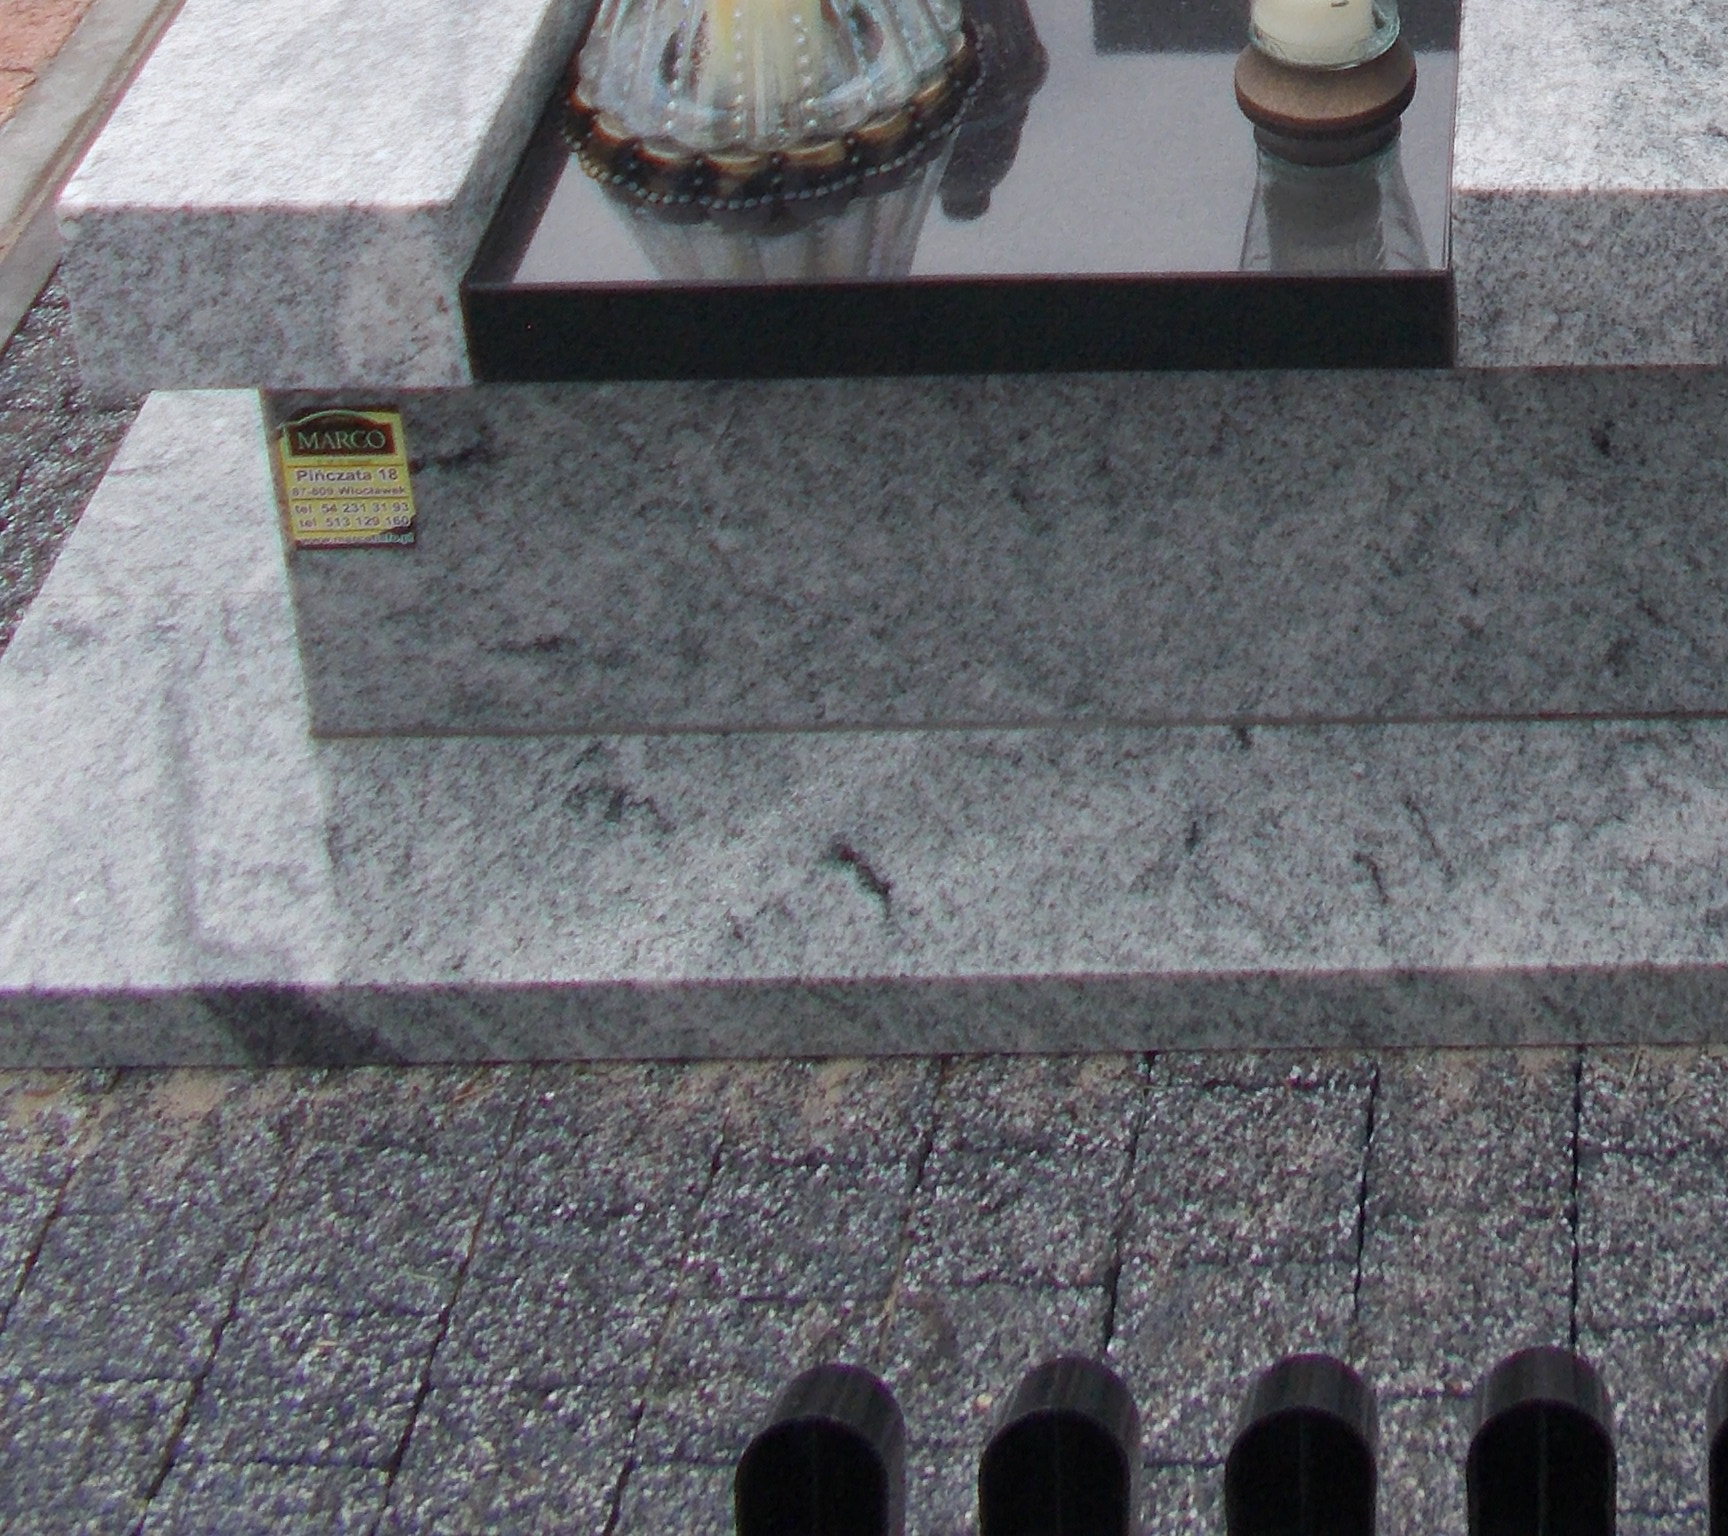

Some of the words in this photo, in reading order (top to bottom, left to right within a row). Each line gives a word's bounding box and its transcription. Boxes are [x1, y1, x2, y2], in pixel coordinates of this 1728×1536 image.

[297, 429, 386, 450] MARCO
[378, 468, 398, 481] 18
[321, 503, 338, 513] 54
[343, 502, 366, 513] 231
[325, 517, 351, 527] 513
